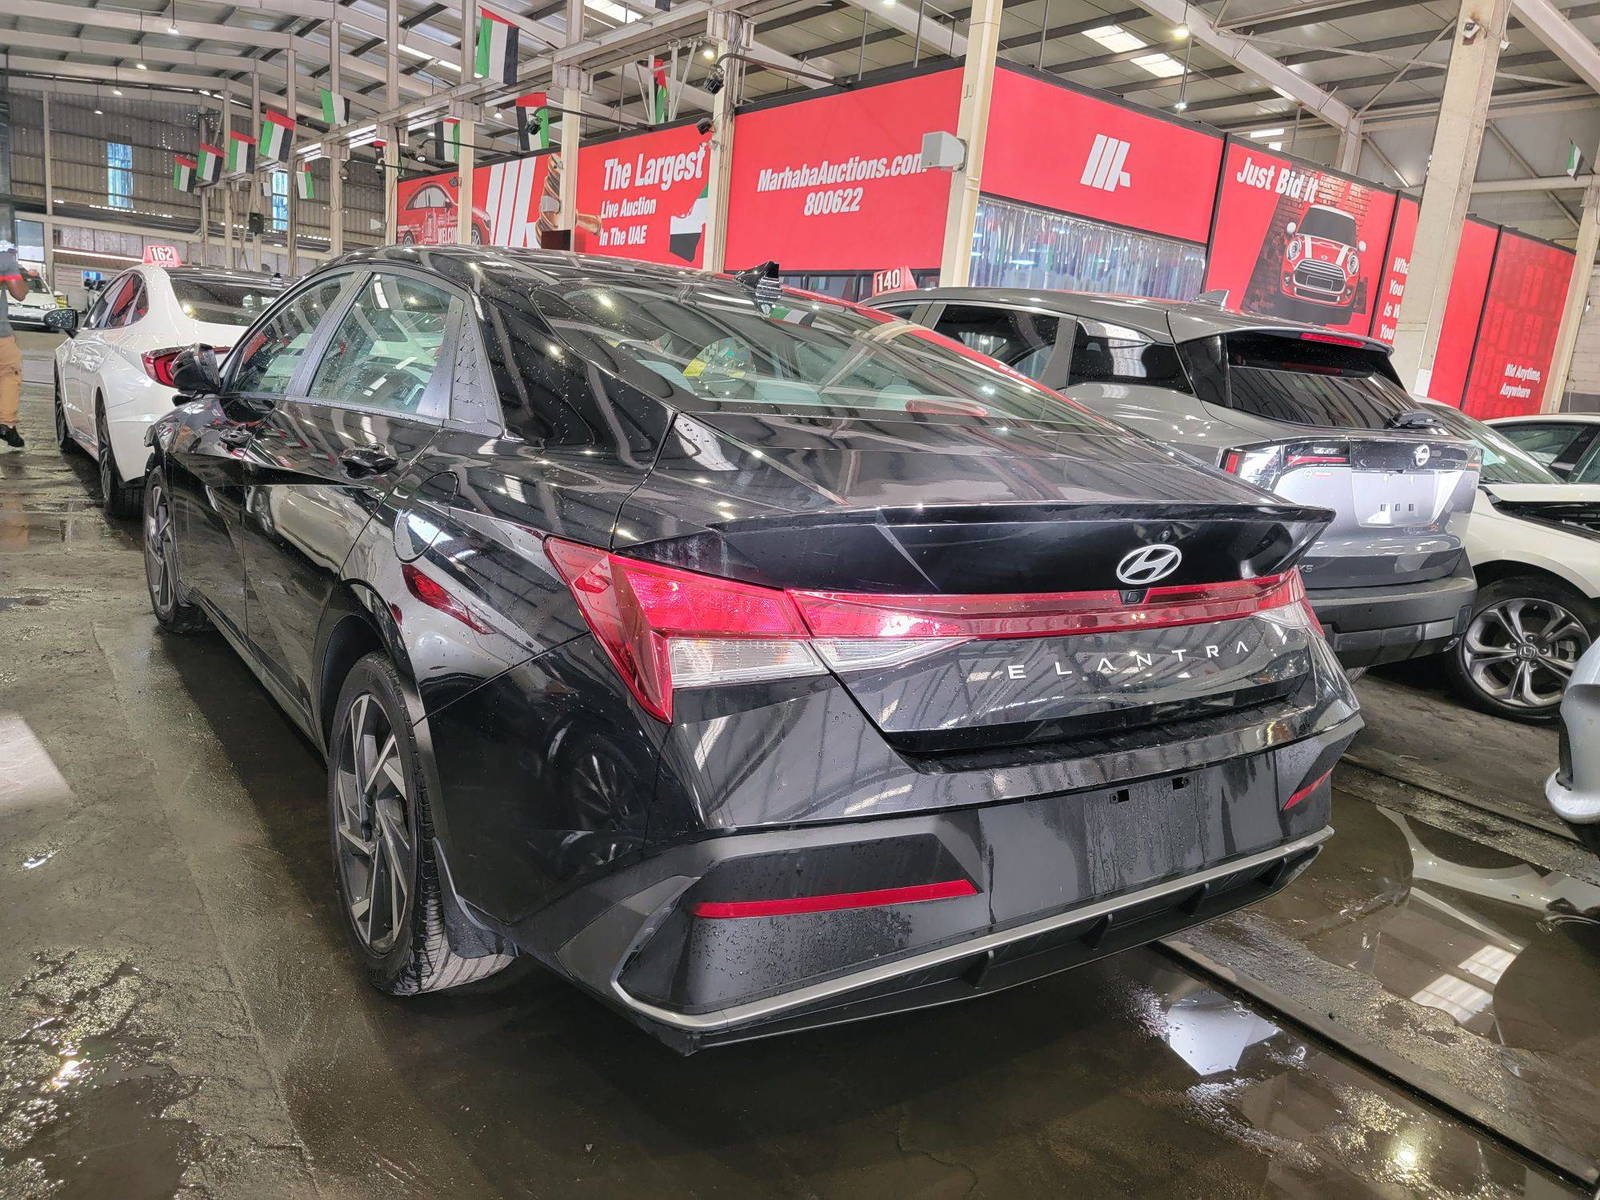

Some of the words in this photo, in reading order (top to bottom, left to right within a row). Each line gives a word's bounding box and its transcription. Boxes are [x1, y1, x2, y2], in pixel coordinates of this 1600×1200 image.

[604, 158, 632, 191] The
[635, 146, 706, 191] Largest
[1237, 157, 1275, 191] Just
[1275, 167, 1303, 200] Bid
[1303, 177, 1320, 204] It
[601, 200, 619, 219] Live
[620, 196, 656, 217] Auction
[804, 188, 863, 216] 800622
[599, 227, 608, 246] In
[610, 227, 626, 246] The
[628, 225, 648, 245] UAE
[151, 247, 173, 261] 162
[877, 269, 901, 292] 140
[1500, 382, 1531, 398] Anywhere
[1007, 641, 1249, 680] ELANTRA
